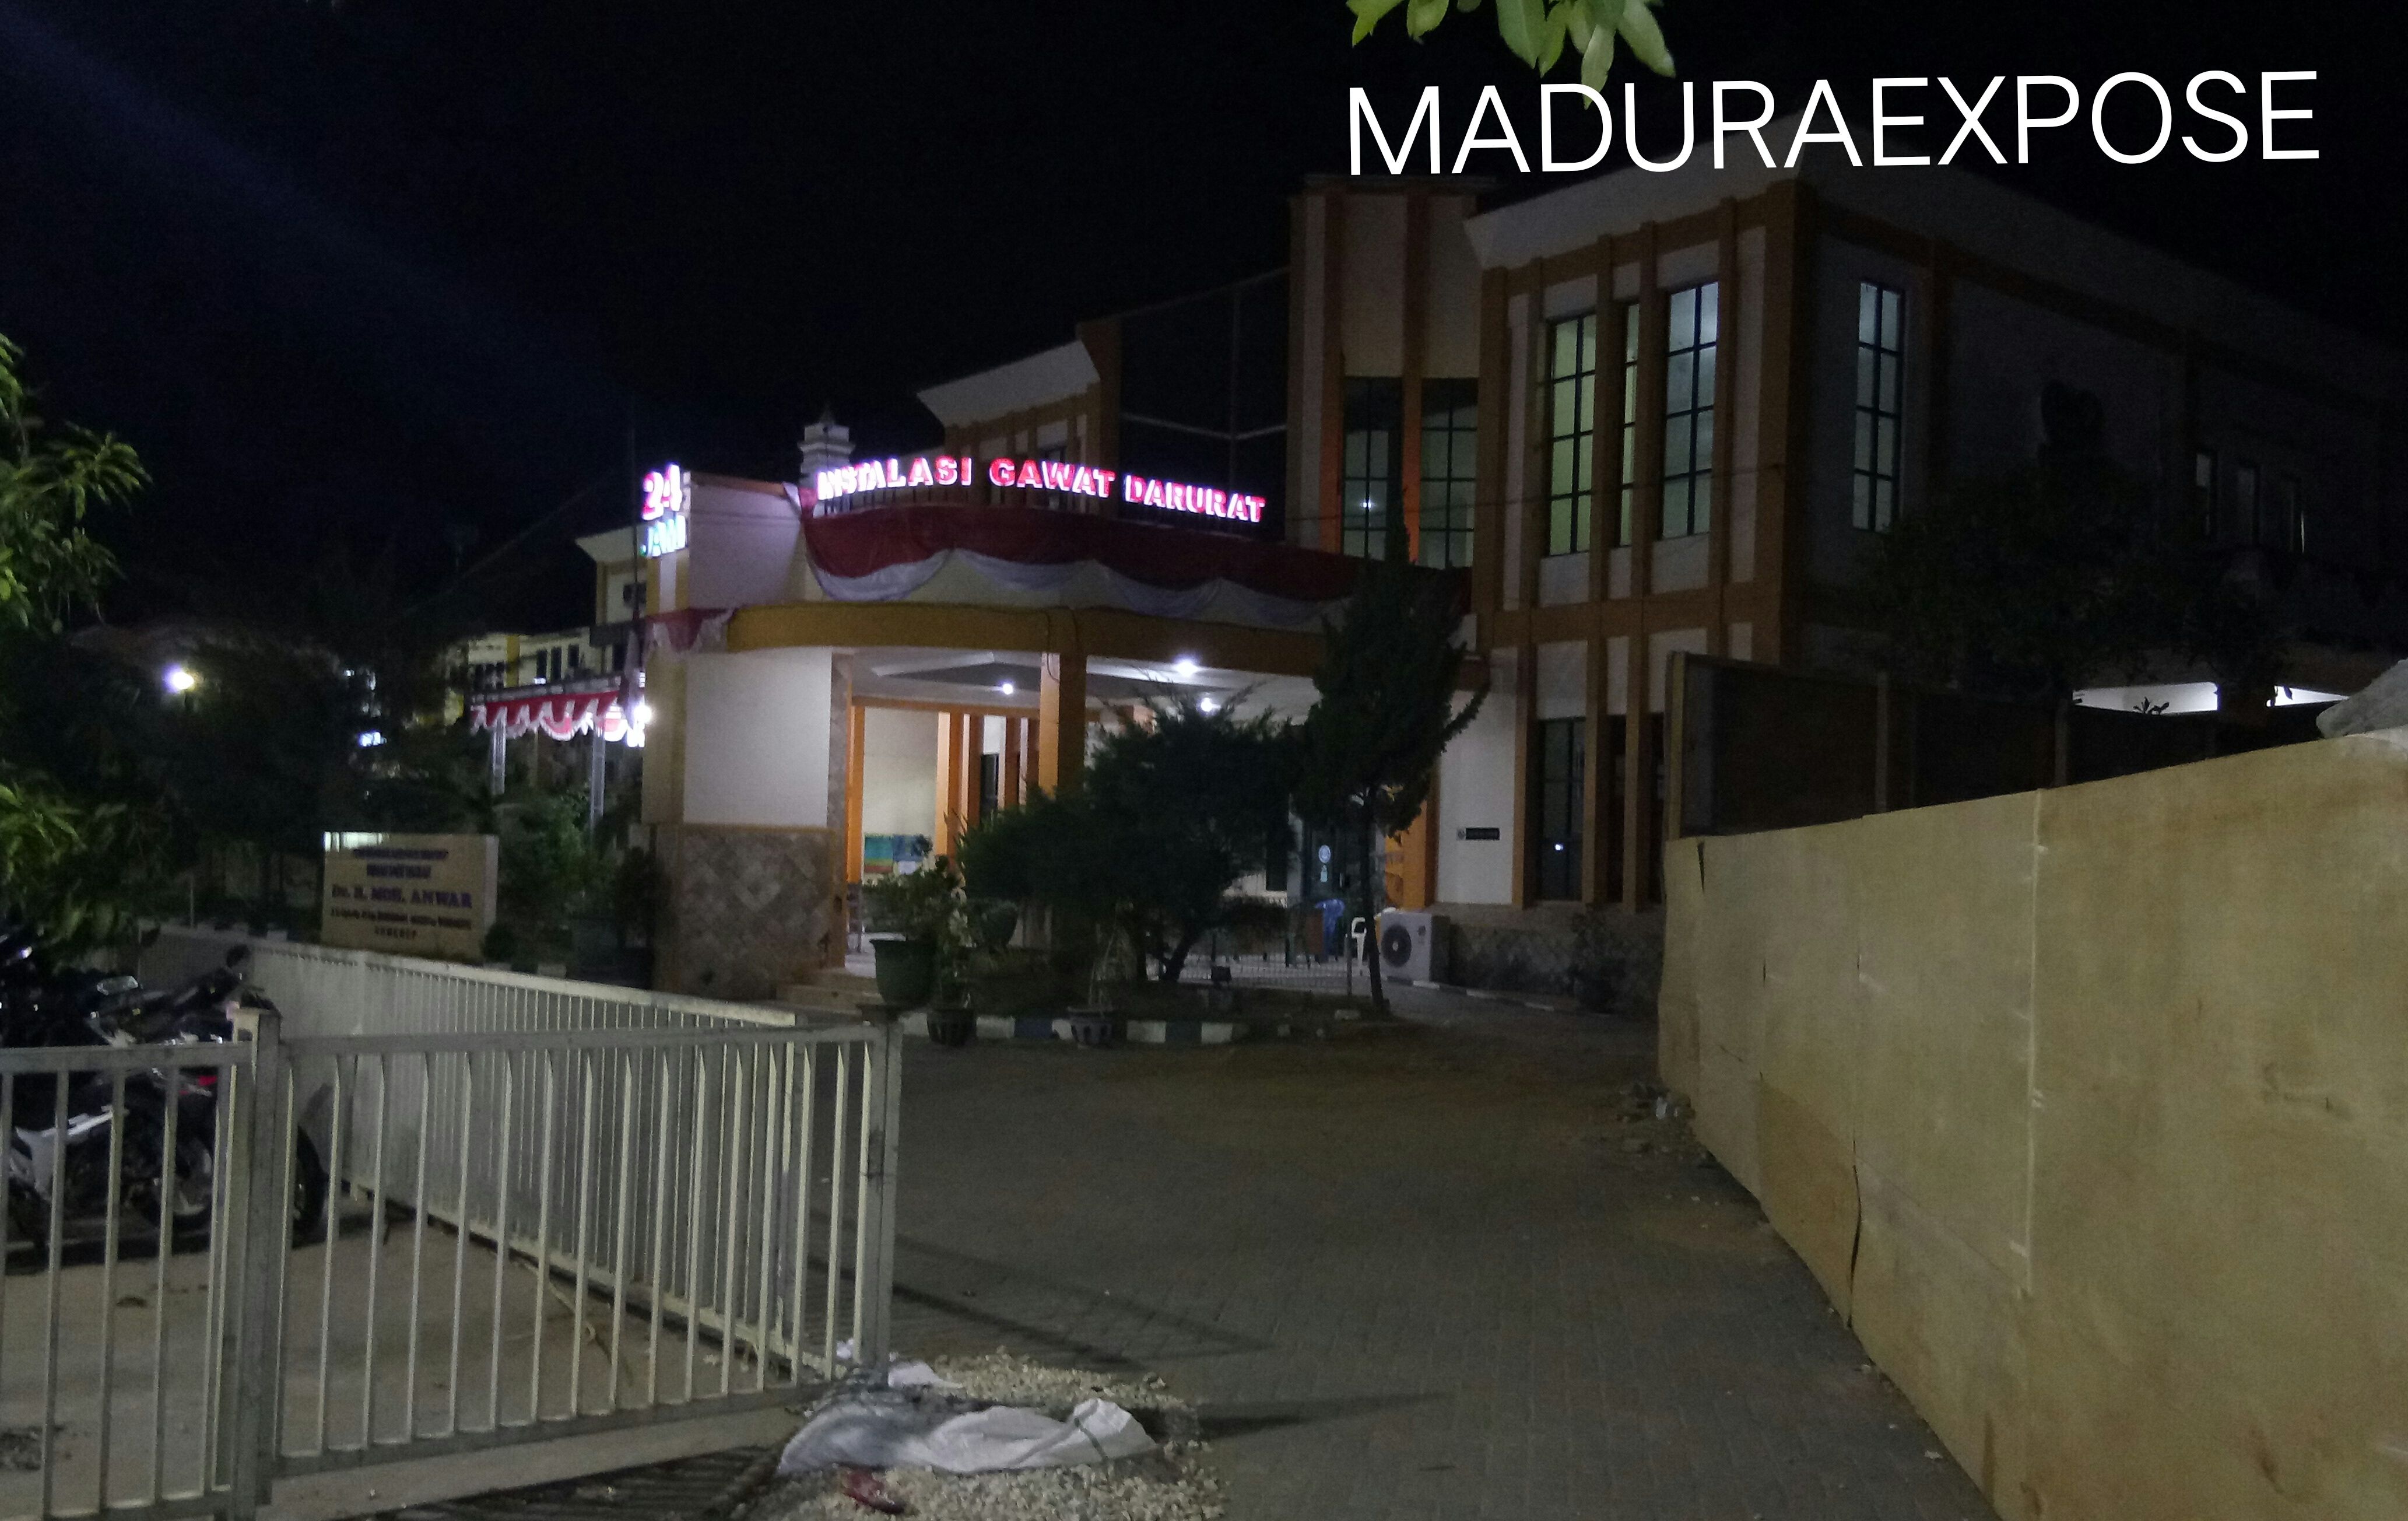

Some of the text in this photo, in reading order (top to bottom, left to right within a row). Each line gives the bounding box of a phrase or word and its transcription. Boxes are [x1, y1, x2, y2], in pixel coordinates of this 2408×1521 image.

[641, 463, 682, 521] 24
[816, 454, 1267, 523] INSTALASI GAWAT DARURAT
[639, 514, 686, 557] JAM
[411, 889, 472, 909] ANWAR
